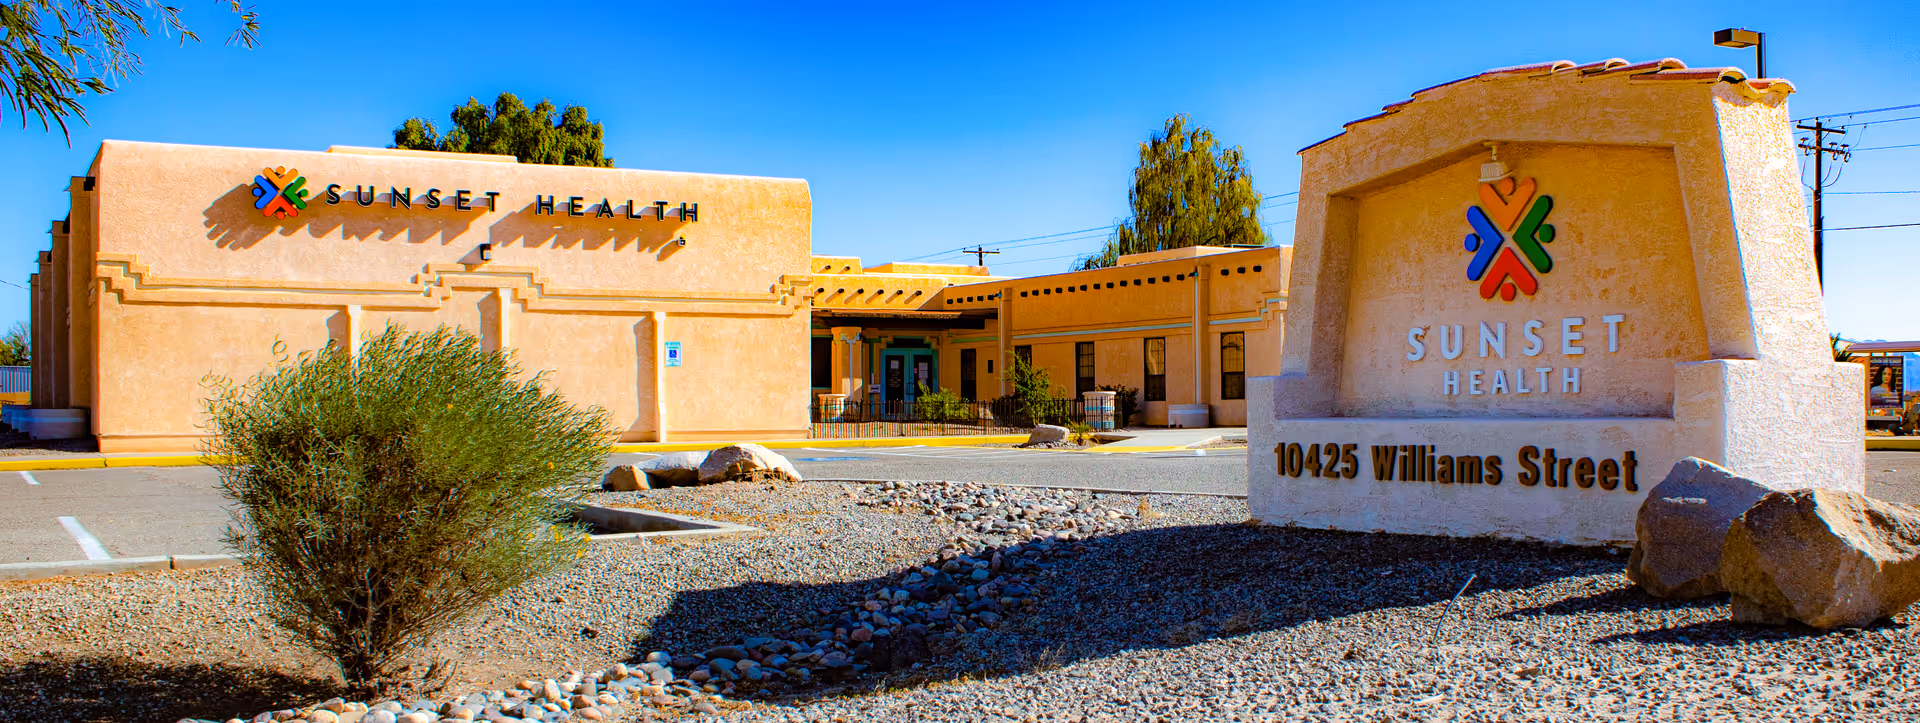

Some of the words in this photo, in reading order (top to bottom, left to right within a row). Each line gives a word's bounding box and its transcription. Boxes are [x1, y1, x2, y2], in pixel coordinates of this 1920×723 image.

[325, 183, 500, 212] SUNSET
[536, 194, 699, 222] HEALTH
[1406, 314, 1625, 362] SUNSET
[1443, 367, 1582, 395] HEALTH
[1274, 442, 1359, 479] 10425
[1370, 444, 1503, 485] Williams
[1517, 445, 1639, 492] Street
